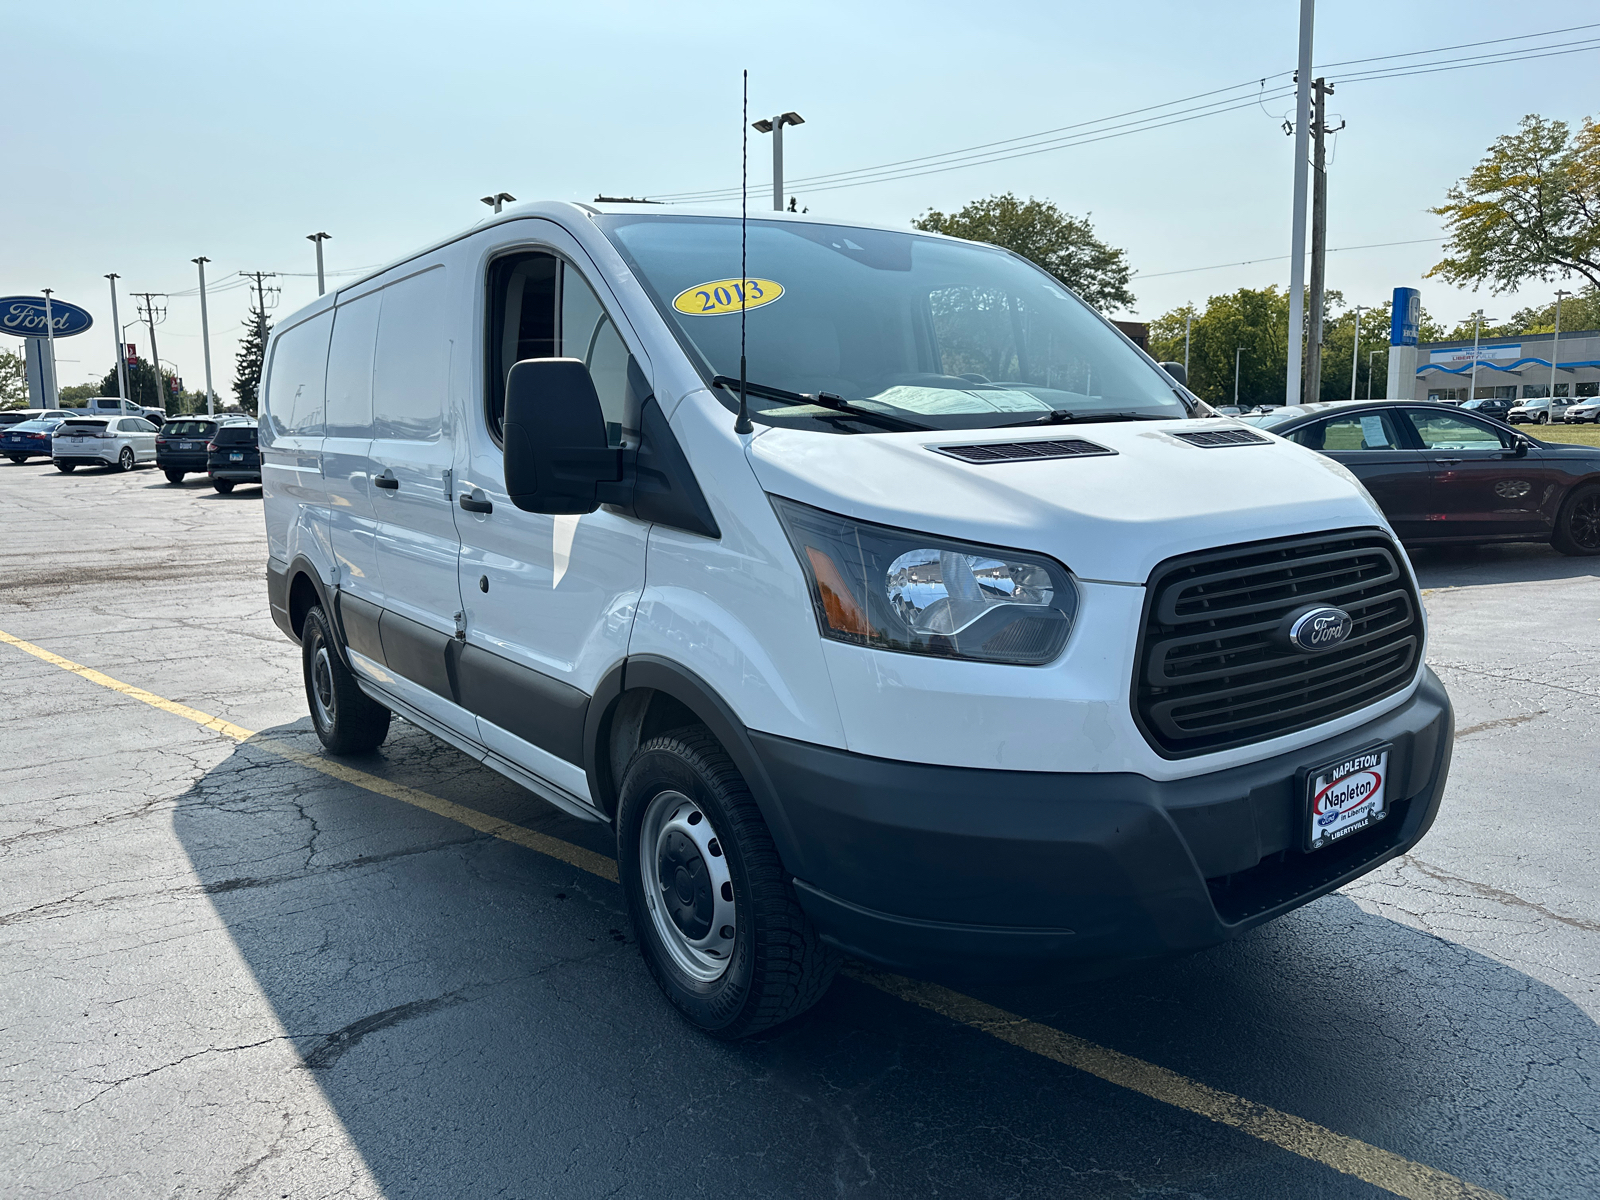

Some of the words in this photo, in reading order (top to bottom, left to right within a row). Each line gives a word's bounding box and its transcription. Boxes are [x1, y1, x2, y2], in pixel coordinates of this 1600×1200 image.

[695, 280, 764, 312] 2013
[3, 303, 70, 330] Ford
[1311, 616, 1344, 645] Ford
[1332, 754, 1378, 781] NAPLETON
[1324, 781, 1371, 810] Napleton
[1340, 813, 1347, 822] in
[1347, 801, 1376, 819] Libertyville
[1331, 818, 1369, 841] LIBERTYVILLE
